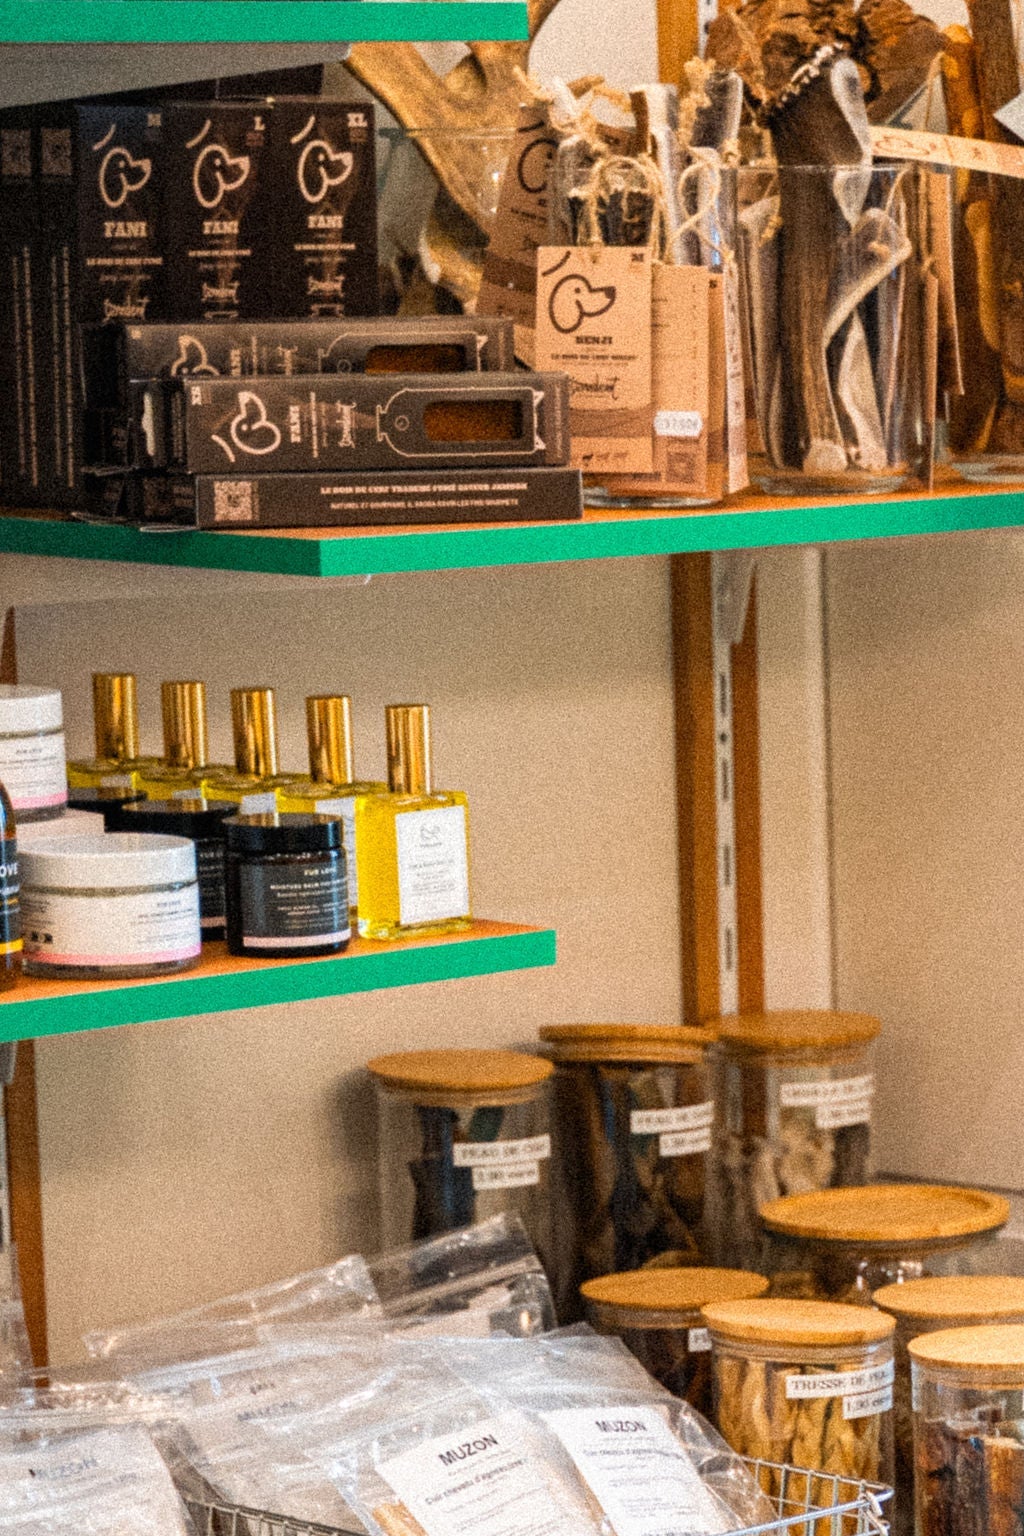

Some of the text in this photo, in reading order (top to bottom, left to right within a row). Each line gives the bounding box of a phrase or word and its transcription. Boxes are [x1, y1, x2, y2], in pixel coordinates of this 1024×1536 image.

[254, 116, 266, 131] L
[347, 112, 367, 127] XL
[103, 221, 148, 238] FANI
[203, 220, 240, 235] FANI
[289, 405, 302, 443] FANI
[594, 1420, 647, 1433] MUZON
[438, 1434, 499, 1466] MUZON
